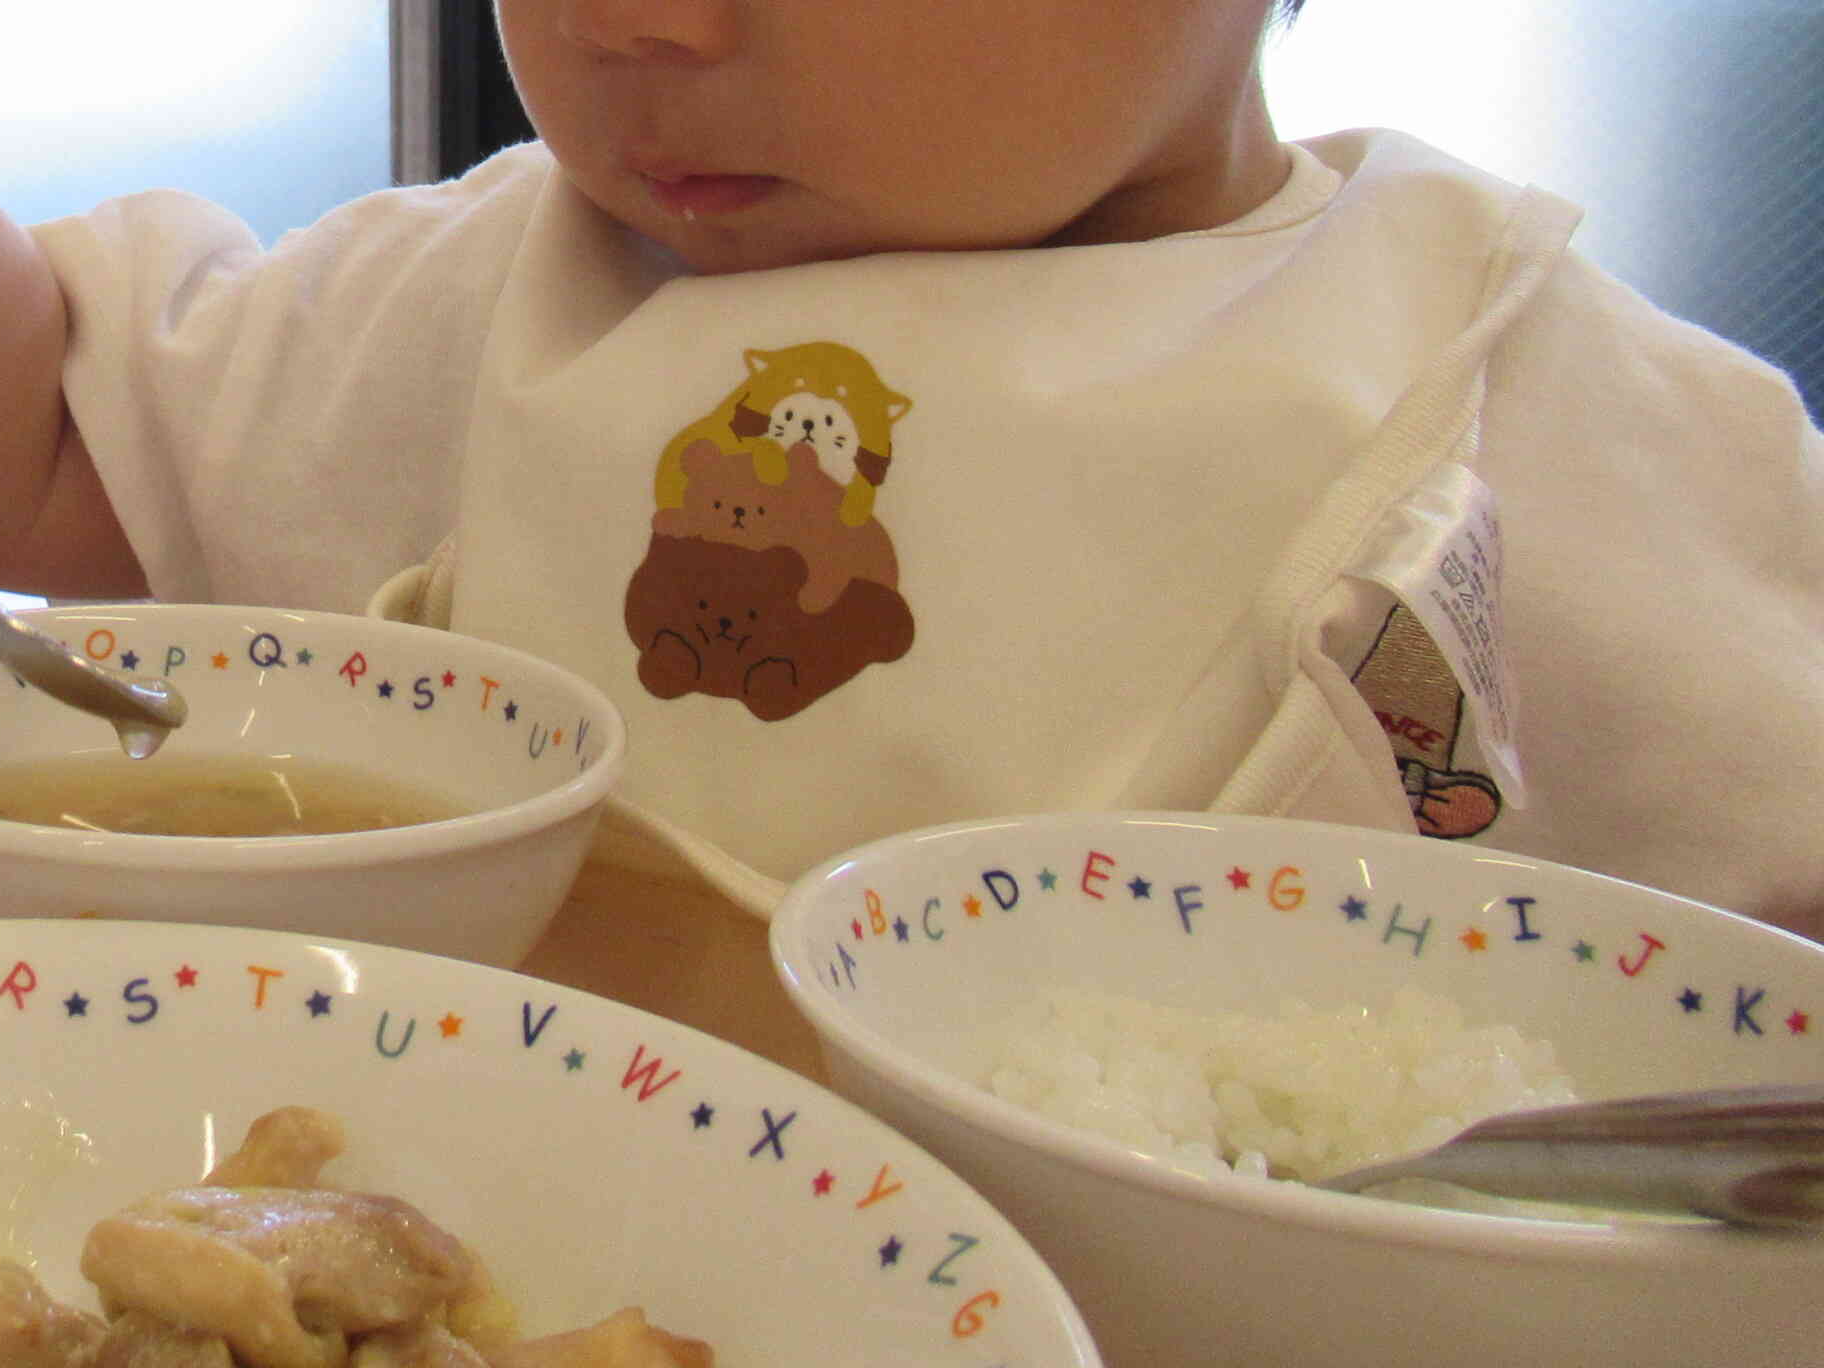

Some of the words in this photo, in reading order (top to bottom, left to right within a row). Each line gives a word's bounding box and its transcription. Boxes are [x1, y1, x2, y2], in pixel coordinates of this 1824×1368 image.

[84, 626, 116, 662] O
[163, 645, 187, 677] P
[248, 632, 287, 668] Q
[338, 651, 368, 688] R
[413, 677, 435, 711] S
[479, 676, 501, 711] T
[528, 721, 549, 759] U
[864, 888, 888, 937] B
[922, 897, 945, 942] C
[981, 869, 1019, 911] D
[1080, 850, 1116, 900] E
[1172, 885, 1204, 934] F
[1267, 865, 1306, 911] G
[1381, 903, 1433, 958] H
[1505, 896, 1541, 942] I
[1617, 932, 1666, 977] J
[1733, 987, 1765, 1035] K
[122, 977, 159, 1025] S
[247, 965, 284, 1009] T
[375, 1010, 417, 1059] U
[522, 1002, 557, 1048] V
[620, 1045, 682, 1103] W
[748, 1108, 797, 1161] X
[855, 1165, 904, 1210] Y
[927, 1232, 980, 1286] Z
